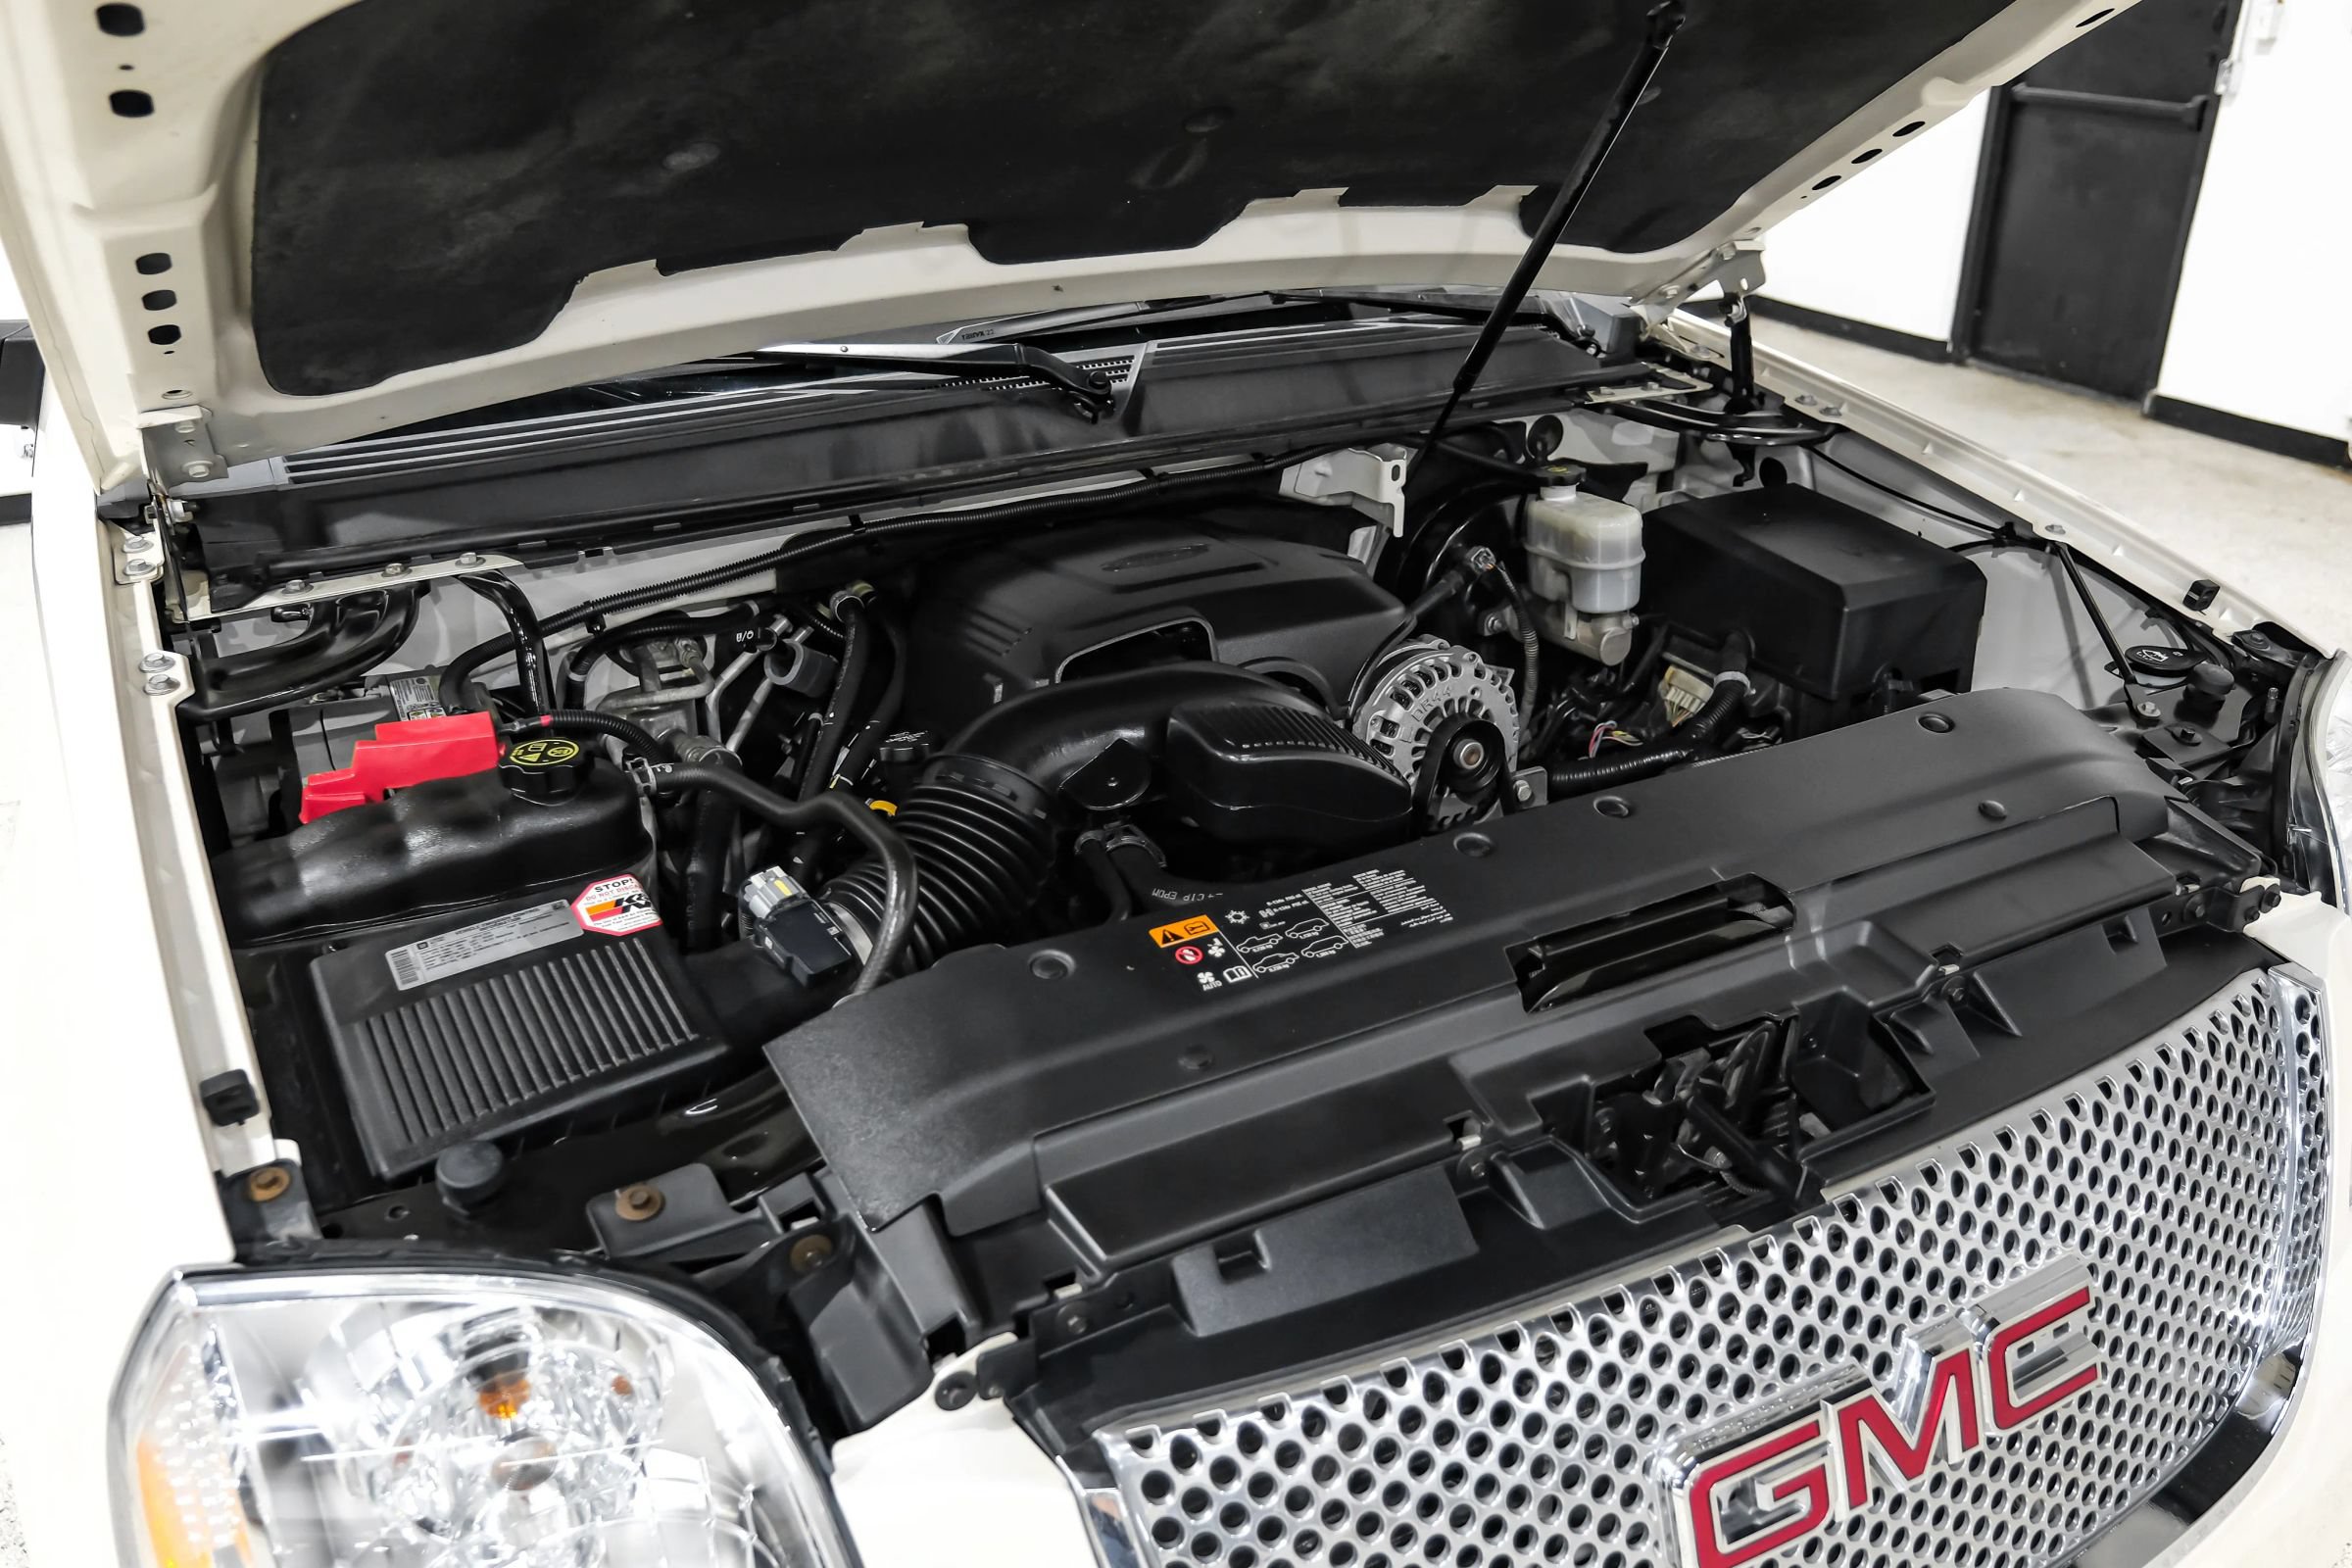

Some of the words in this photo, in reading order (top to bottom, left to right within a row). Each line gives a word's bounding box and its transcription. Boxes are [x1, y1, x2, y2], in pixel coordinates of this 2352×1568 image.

[594, 878, 634, 893] STOP!
[1202, 981, 1222, 991] AUTO
[1685, 1282, 2103, 1568] GMC
